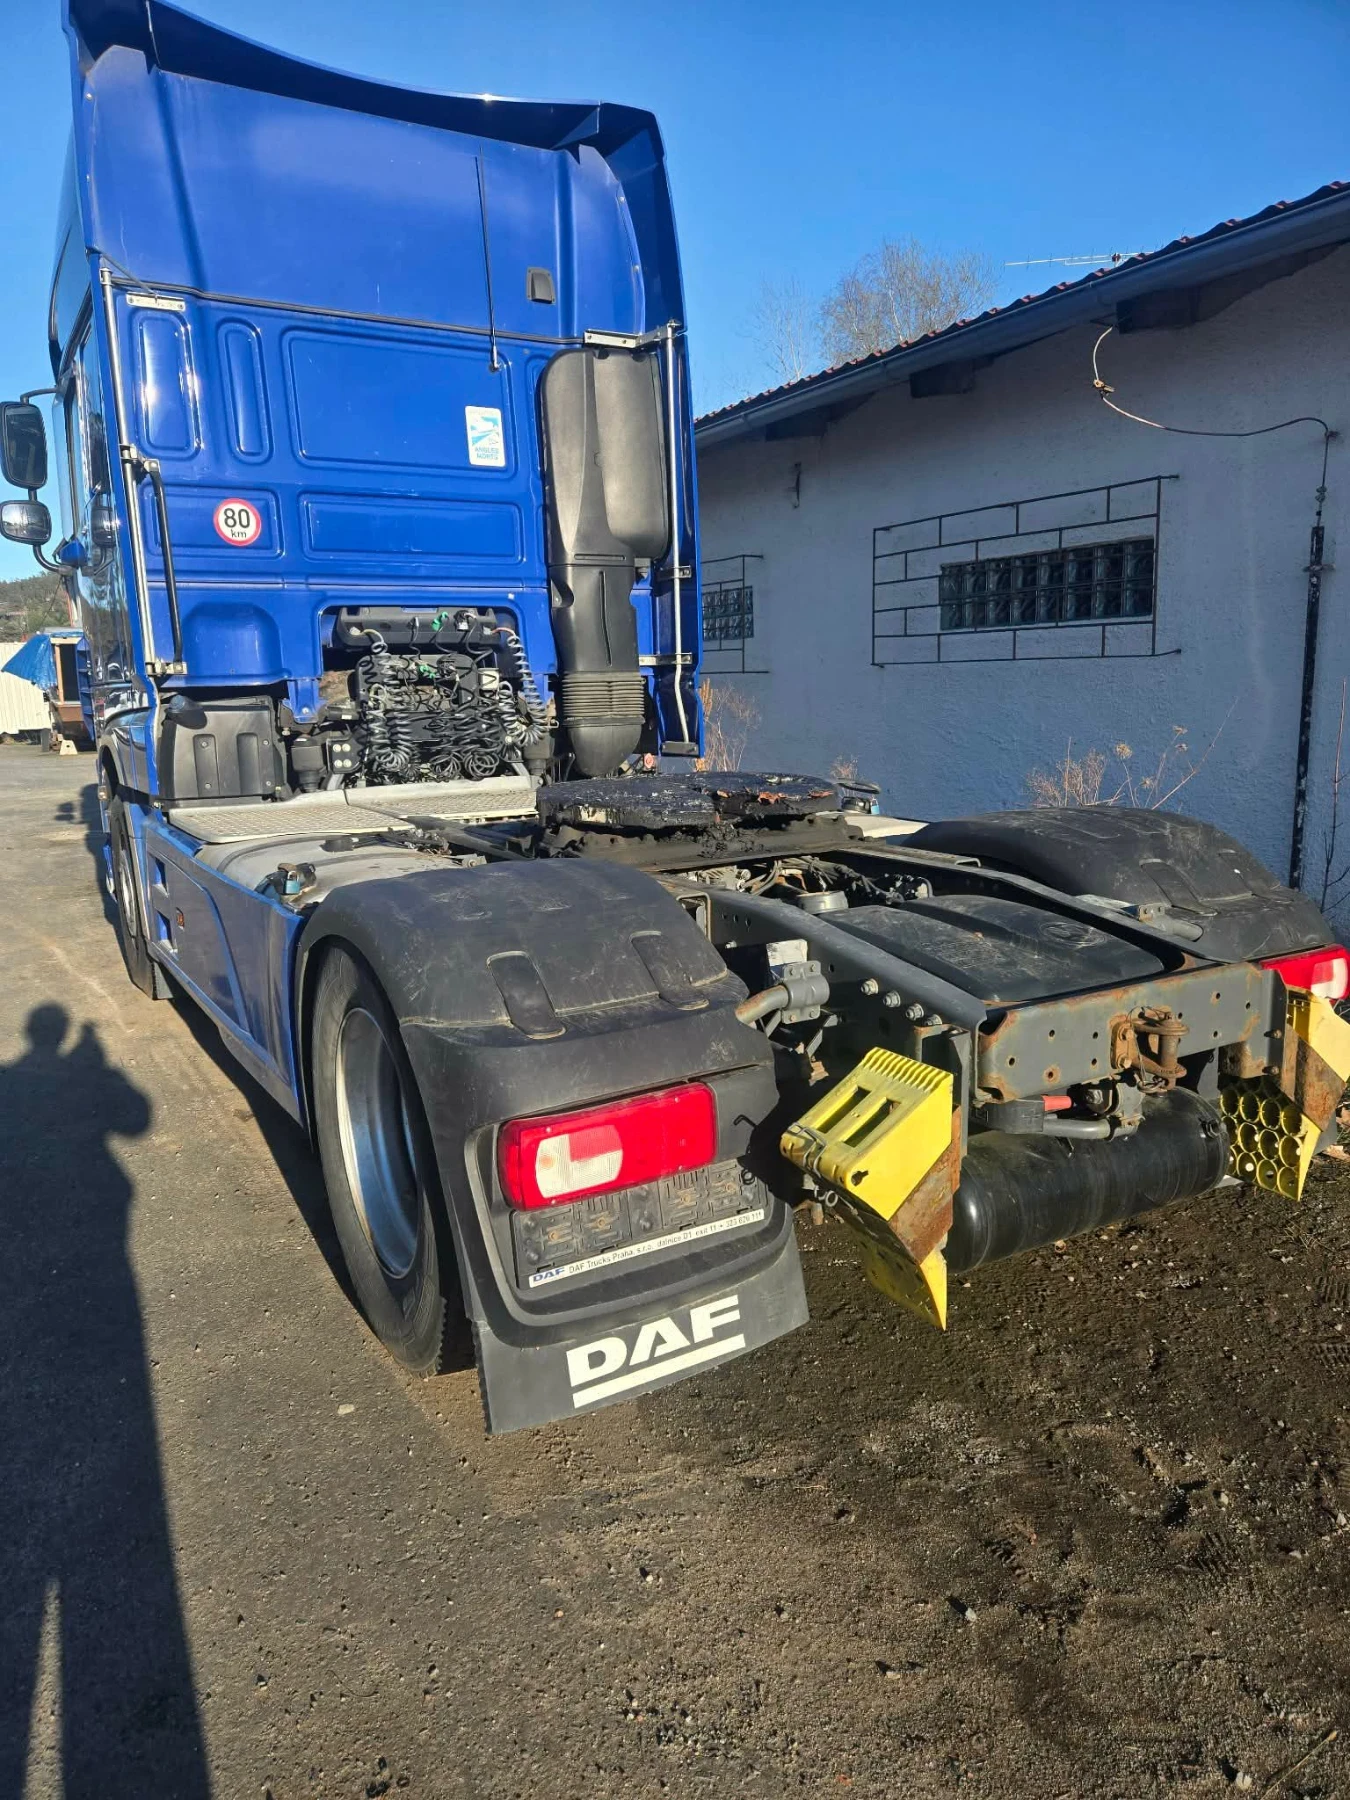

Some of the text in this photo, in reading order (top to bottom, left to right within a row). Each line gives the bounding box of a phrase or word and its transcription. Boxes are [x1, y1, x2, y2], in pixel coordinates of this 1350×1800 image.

[224, 508, 250, 528] 80
[230, 529, 247, 538] km
[533, 1267, 565, 1282] DAF
[568, 1263, 585, 1274] DAF
[587, 1256, 611, 1268] Trucks
[566, 1294, 741, 1387] DAF
